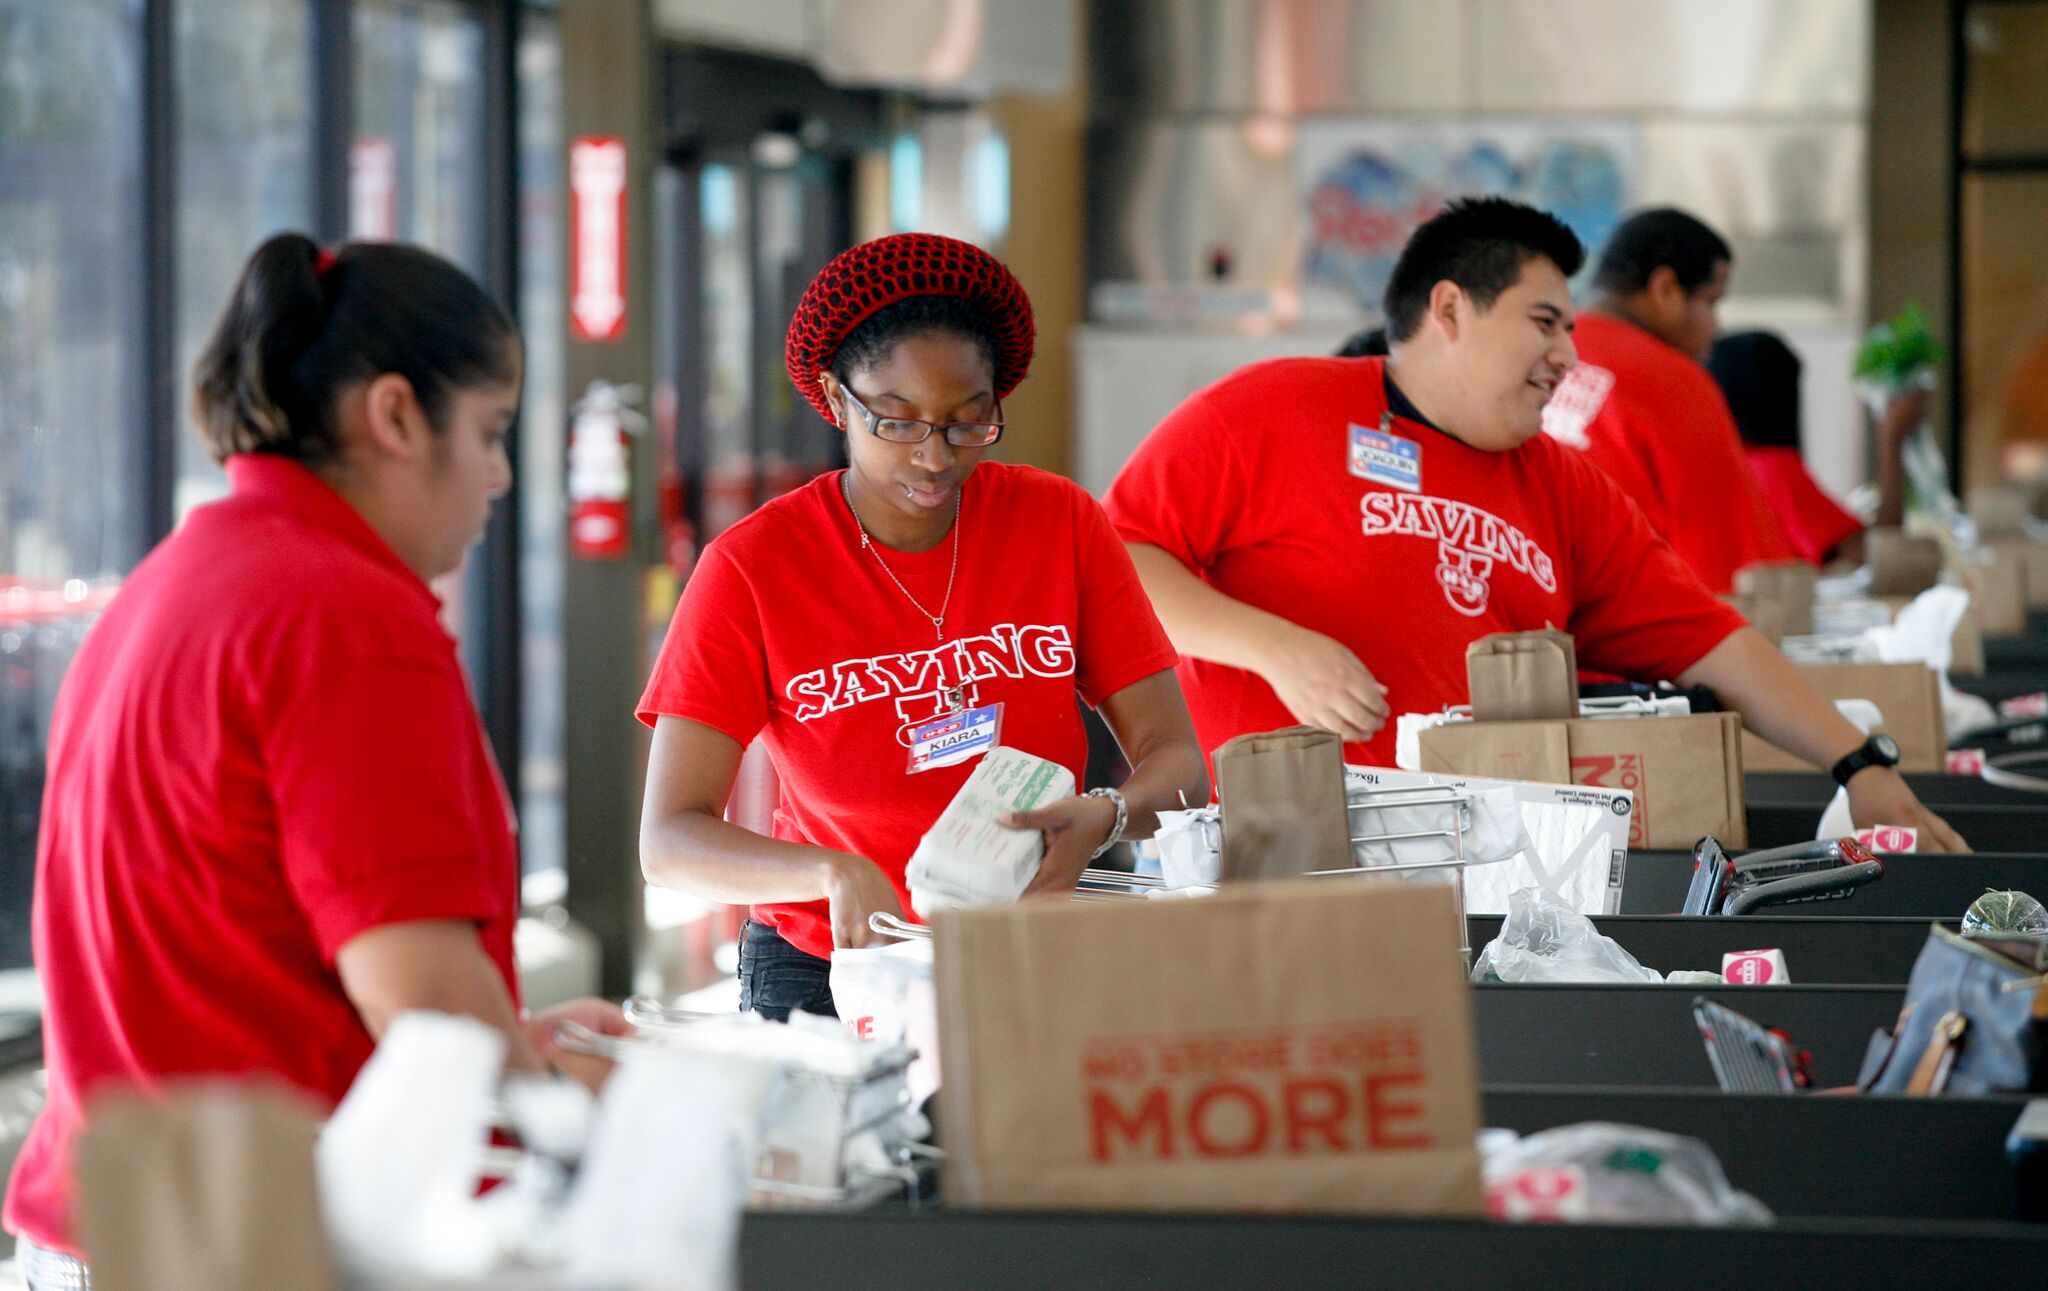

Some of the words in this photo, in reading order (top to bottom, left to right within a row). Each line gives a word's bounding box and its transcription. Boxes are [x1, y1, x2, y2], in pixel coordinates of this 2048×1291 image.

[1360, 492, 1557, 594] SAVING
[785, 623, 1076, 722] SAVING
[929, 728, 980, 752] KIARA
[1087, 1071, 1433, 1164] MORE
